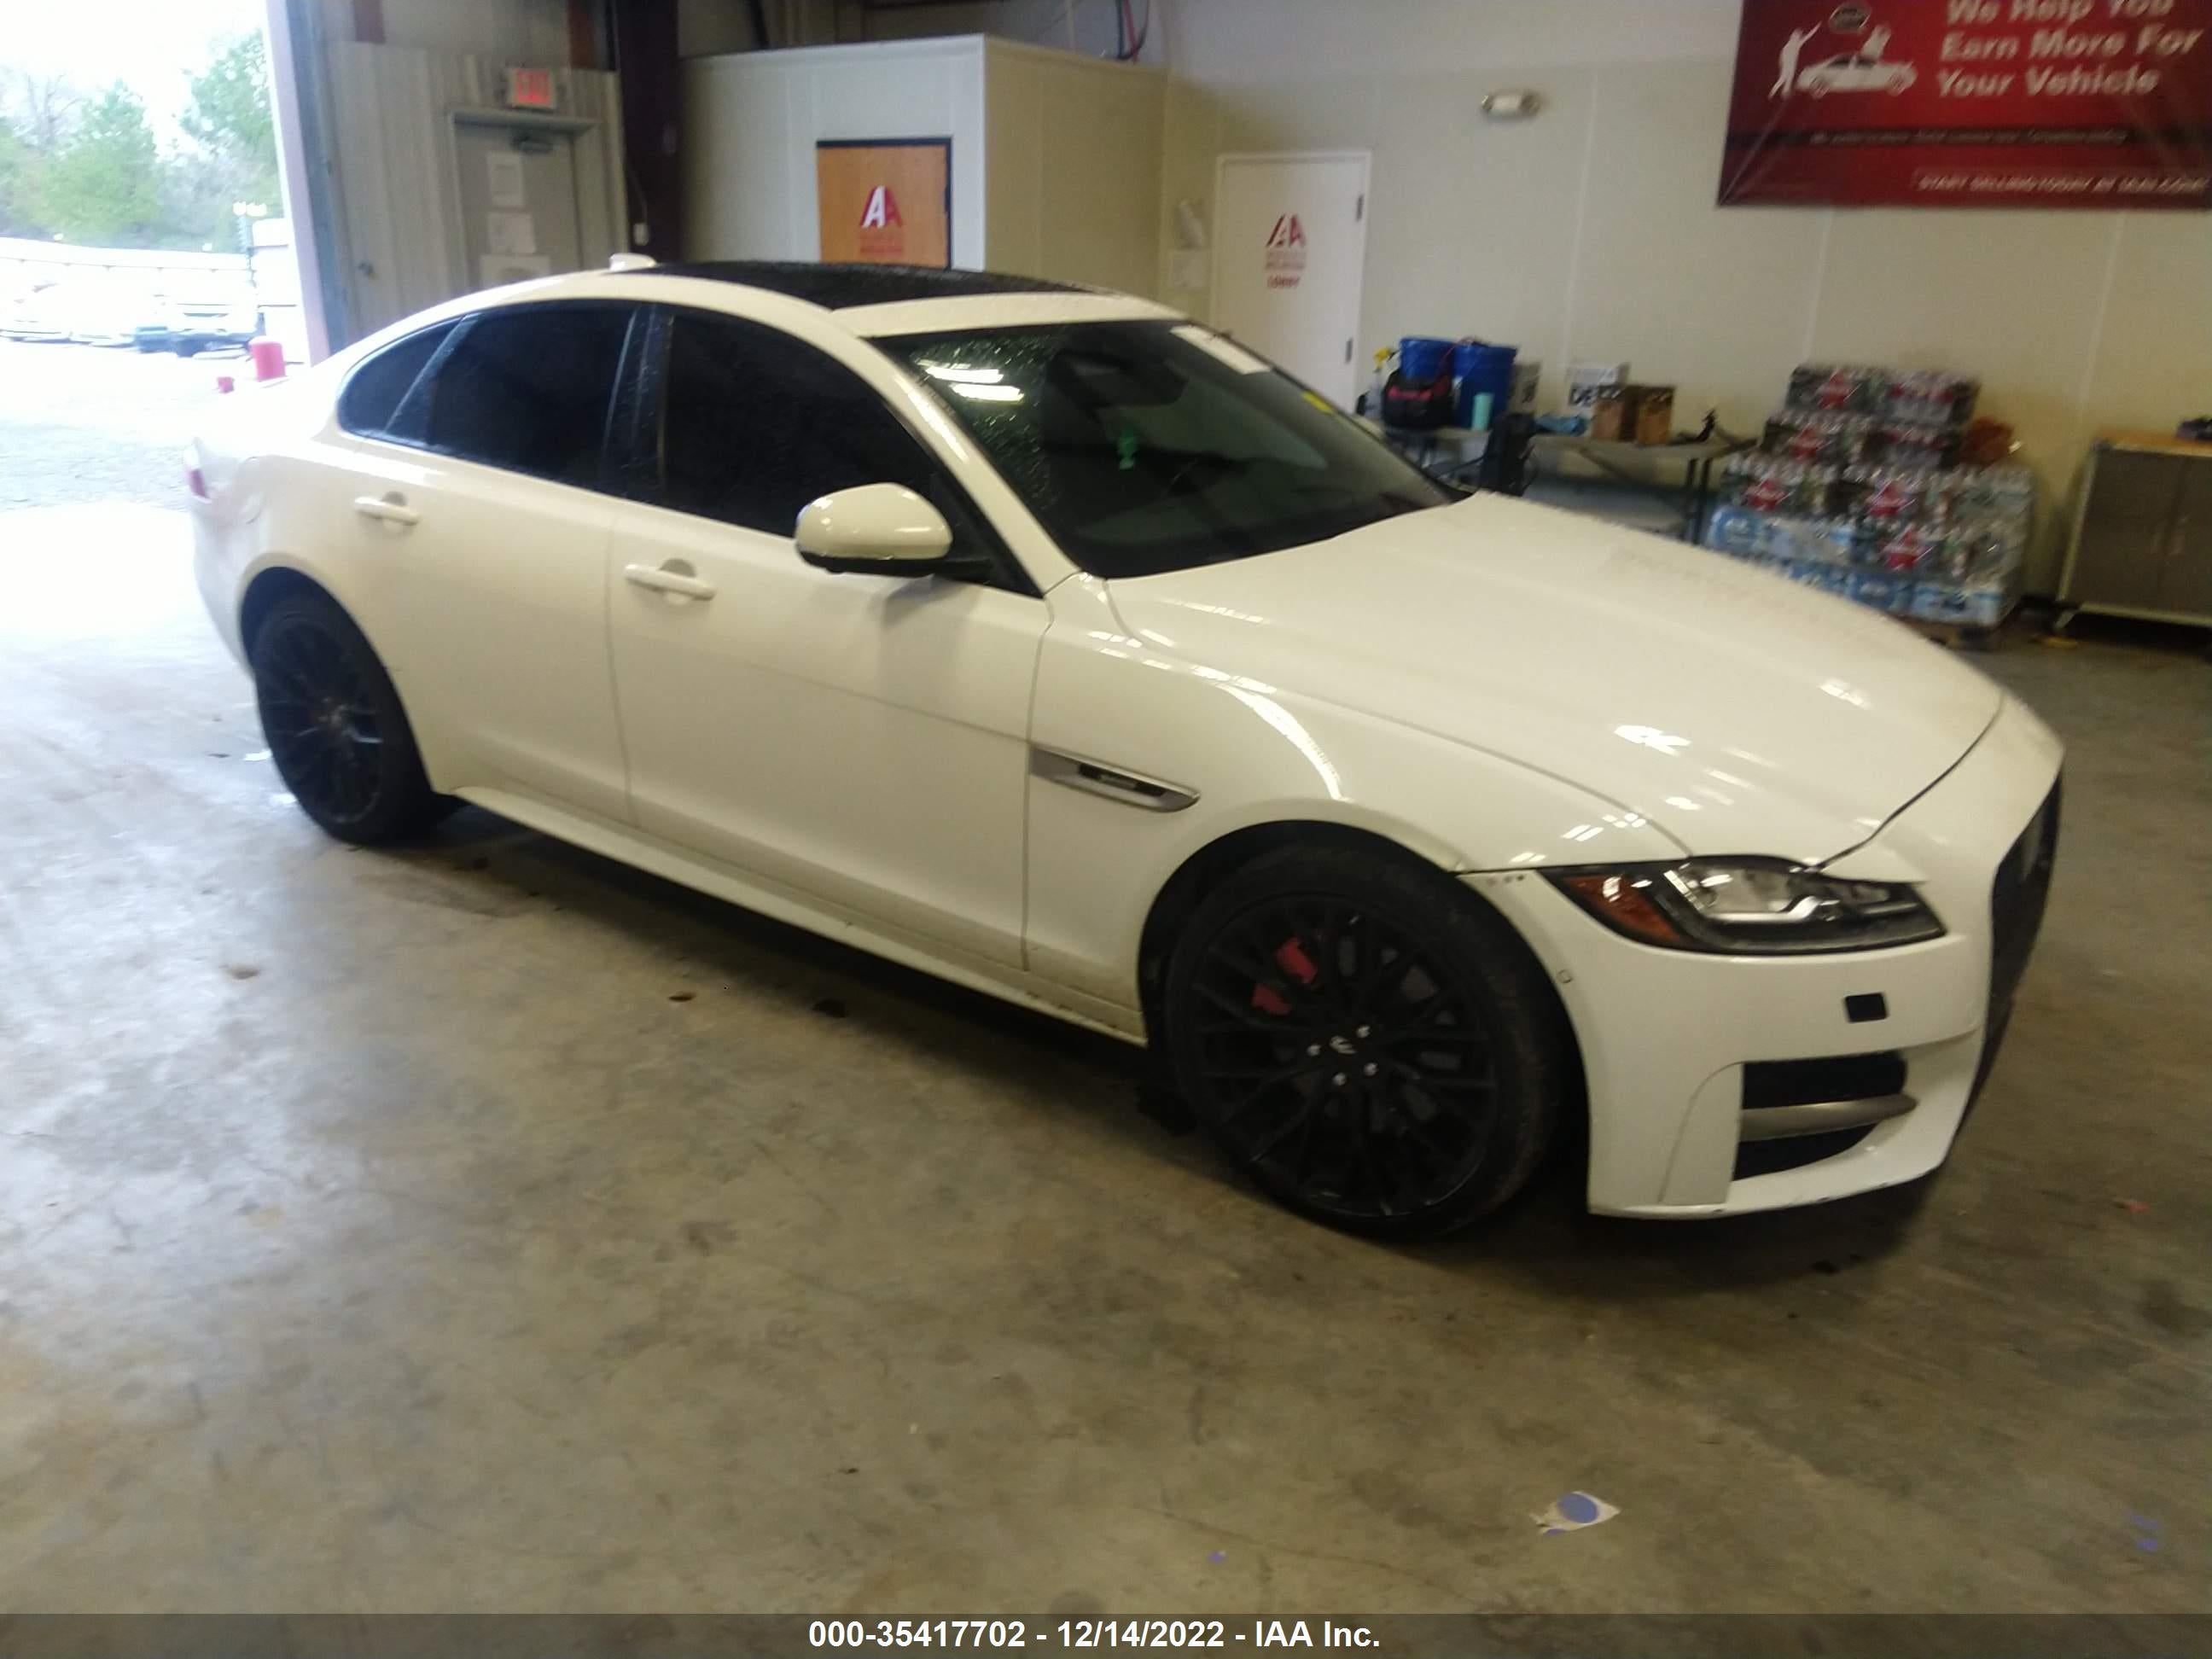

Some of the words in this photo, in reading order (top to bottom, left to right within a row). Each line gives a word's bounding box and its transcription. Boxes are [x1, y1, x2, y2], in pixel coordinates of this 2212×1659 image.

[1940, 31, 2021, 61] Earn
[2028, 27, 2126, 59] More
[2135, 22, 2203, 55] For
[1936, 67, 2015, 97] Your
[2024, 64, 2160, 96] Vehicle
